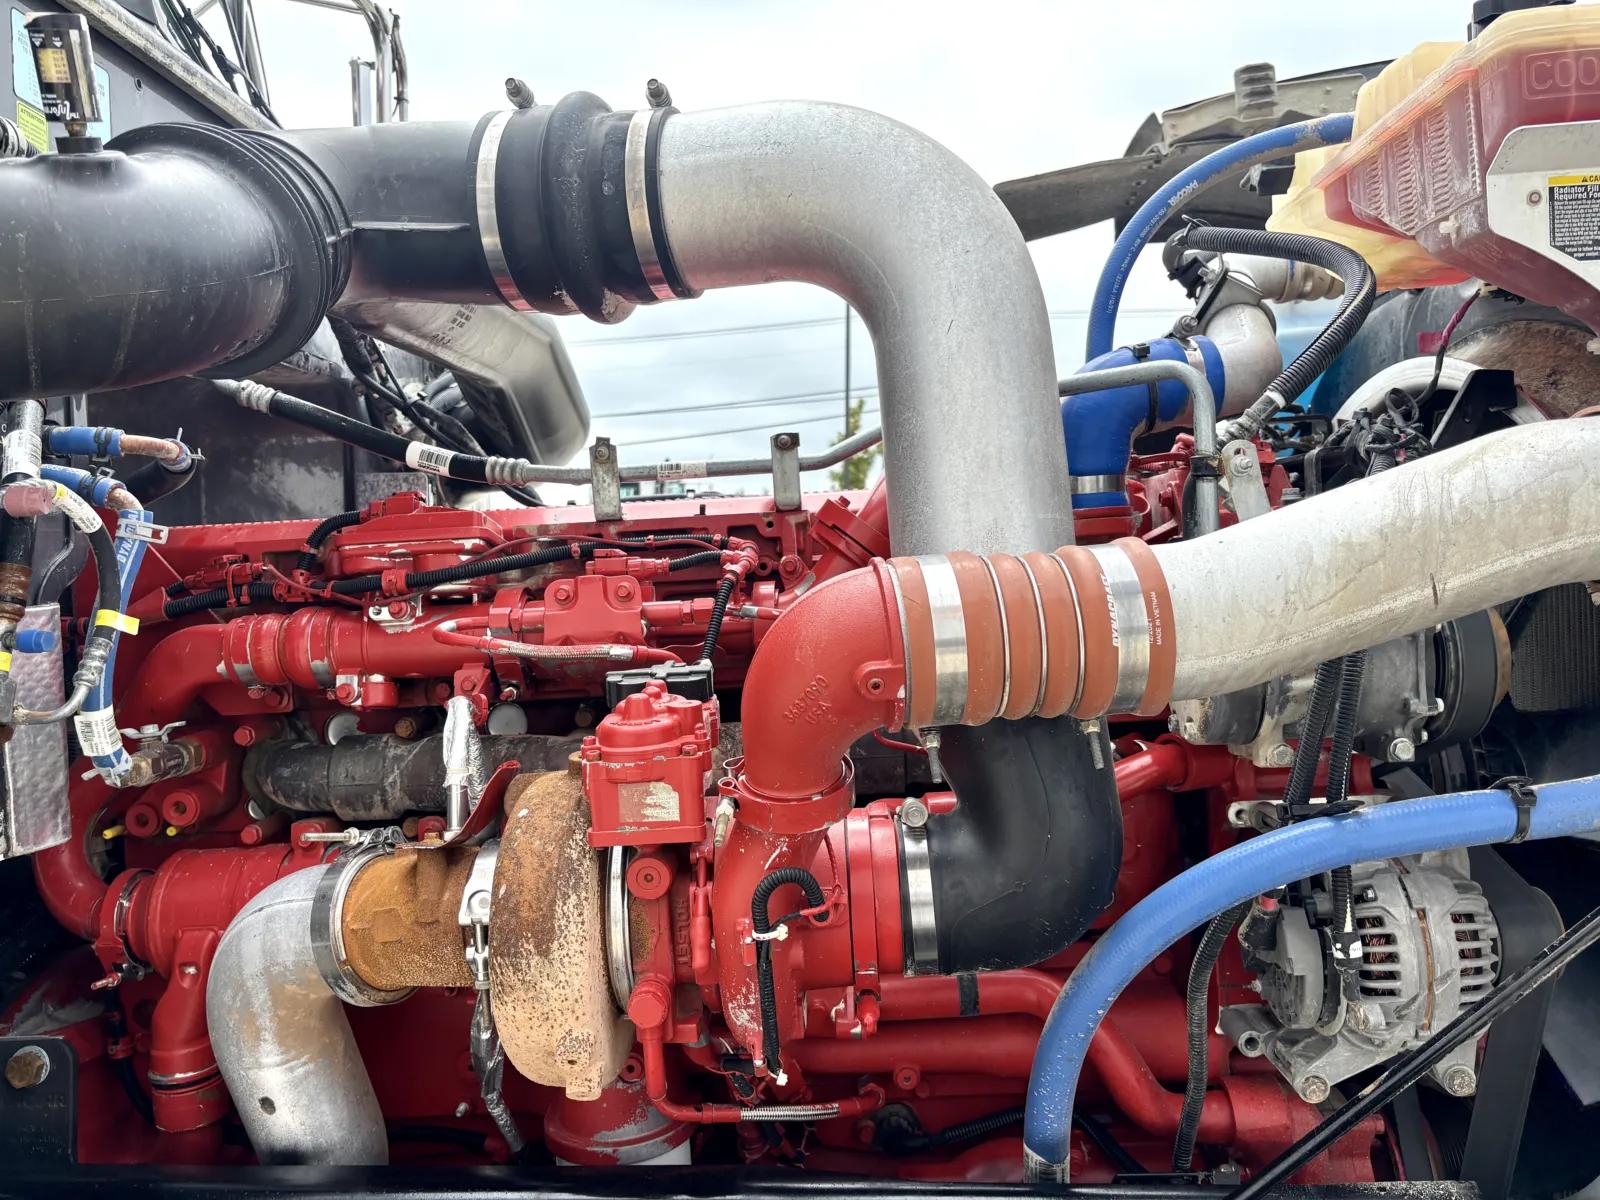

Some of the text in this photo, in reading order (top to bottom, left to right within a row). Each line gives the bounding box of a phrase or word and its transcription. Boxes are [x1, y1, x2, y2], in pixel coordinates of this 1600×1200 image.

[1589, 175, 1600, 183] CA
[1168, 180, 1199, 206] PACCAR
[1554, 185, 1599, 194] Radiator Fill
[1554, 191, 1587, 201] Required
[1150, 591, 1161, 619] VIETNAM
[805, 701, 832, 724] USA
